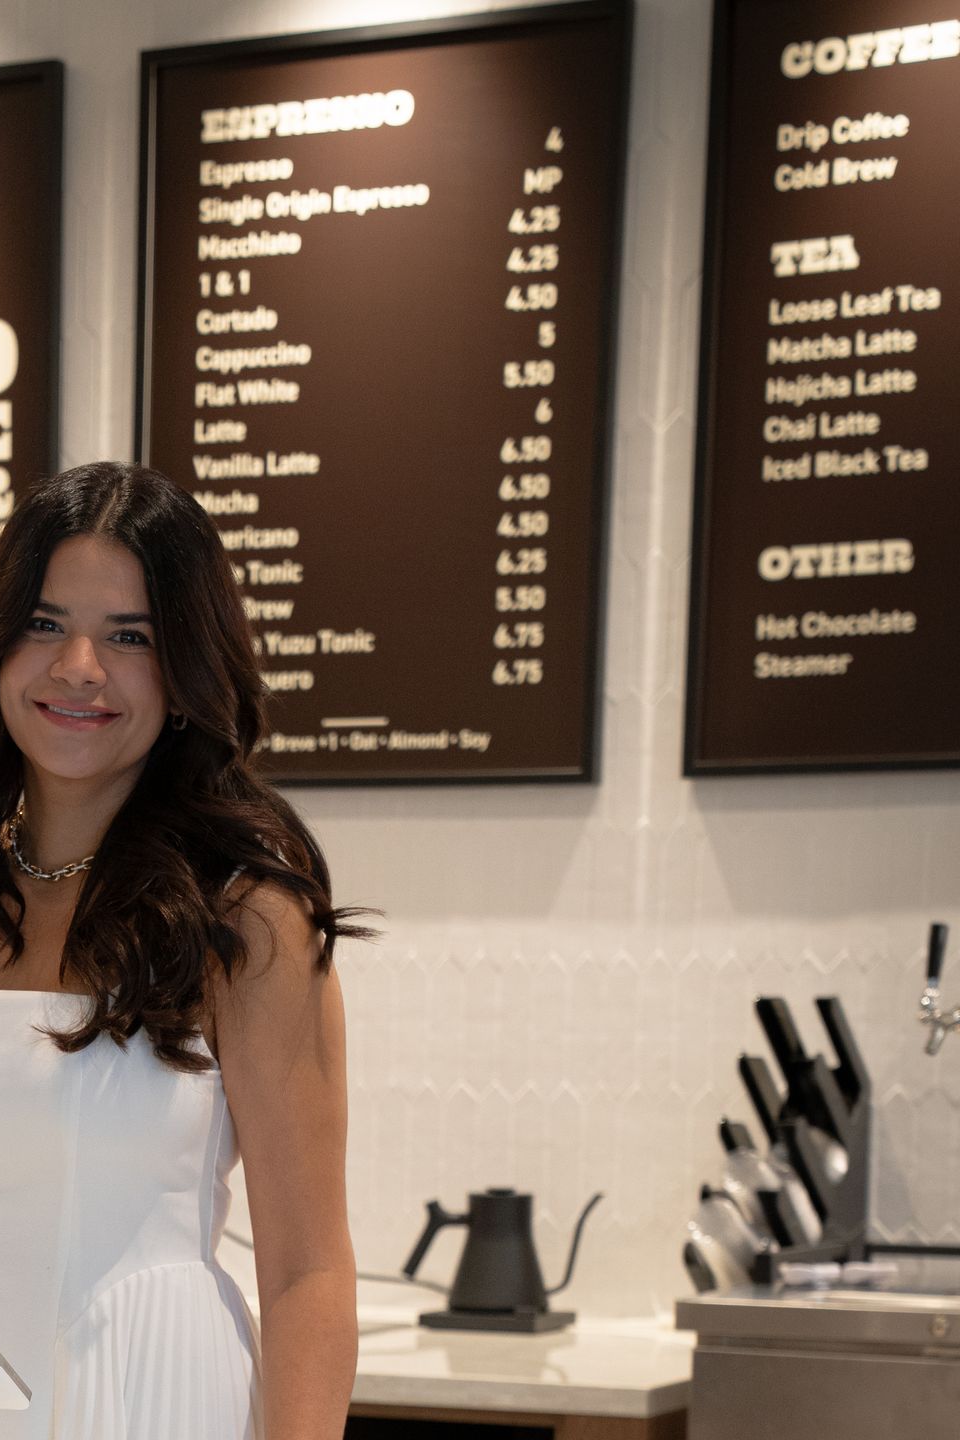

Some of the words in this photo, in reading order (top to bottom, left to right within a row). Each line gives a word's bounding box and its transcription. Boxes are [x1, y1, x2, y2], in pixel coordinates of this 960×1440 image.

[781, 19, 960, 79] COFFEE
[201, 89, 415, 143] ESPRESSO
[545, 126, 564, 152] 4
[777, 121, 830, 153] Drip
[832, 112, 910, 144] Coffee
[200, 158, 293, 188] Espresso
[774, 159, 830, 192] Cold
[832, 156, 898, 185] Brew
[199, 194, 264, 226] Single
[266, 188, 331, 221] Origin
[333, 184, 430, 216] Espresso
[508, 205, 560, 234] 4.25
[198, 231, 302, 260] Macchiato
[506, 244, 559, 273] 4.25
[770, 234, 860, 278] TEA
[199, 272, 211, 298] 1
[215, 270, 234, 296] &
[238, 269, 250, 295] 1
[505, 283, 558, 311] 4.50
[768, 297, 838, 326] Loose
[840, 286, 893, 318] Leaf
[895, 284, 941, 312] Tea
[196, 305, 278, 335] Cortado
[538, 321, 556, 348] 5
[196, 340, 312, 375] Cappuccino
[766, 332, 852, 365] Matcha
[855, 328, 918, 357] Latte
[503, 359, 555, 388] 5.50
[765, 371, 852, 407] Hojicha
[854, 368, 918, 397] Latte
[195, 381, 236, 408] Flat
[237, 377, 300, 405] White
[535, 398, 553, 424] 6
[194, 420, 247, 443] Latte
[763, 413, 817, 443] Chai
[818, 411, 881, 439] Latte
[500, 435, 552, 463] 6.50
[761, 454, 812, 482] Iced
[813, 449, 881, 478] Black
[883, 445, 929, 473] Tea
[193, 454, 265, 479] Vanilla
[266, 451, 320, 476] Latte
[498, 473, 551, 501] 6.50
[193, 490, 259, 515] Mocha
[497, 510, 549, 538] 4.50
[247, 559, 303, 585] Tonic
[496, 548, 547, 576] 6.25
[758, 538, 915, 582] OTHER
[495, 585, 546, 612] 5.50
[493, 622, 544, 649] 6.75
[755, 613, 800, 641] Hot
[800, 608, 917, 639] Chocolate
[264, 631, 317, 656] Yuzu
[318, 628, 376, 653] Tonic
[492, 658, 543, 686] 6.75
[754, 652, 853, 679] Steamer
[387, 728, 449, 751] Almond
[459, 728, 491, 753] Soy
